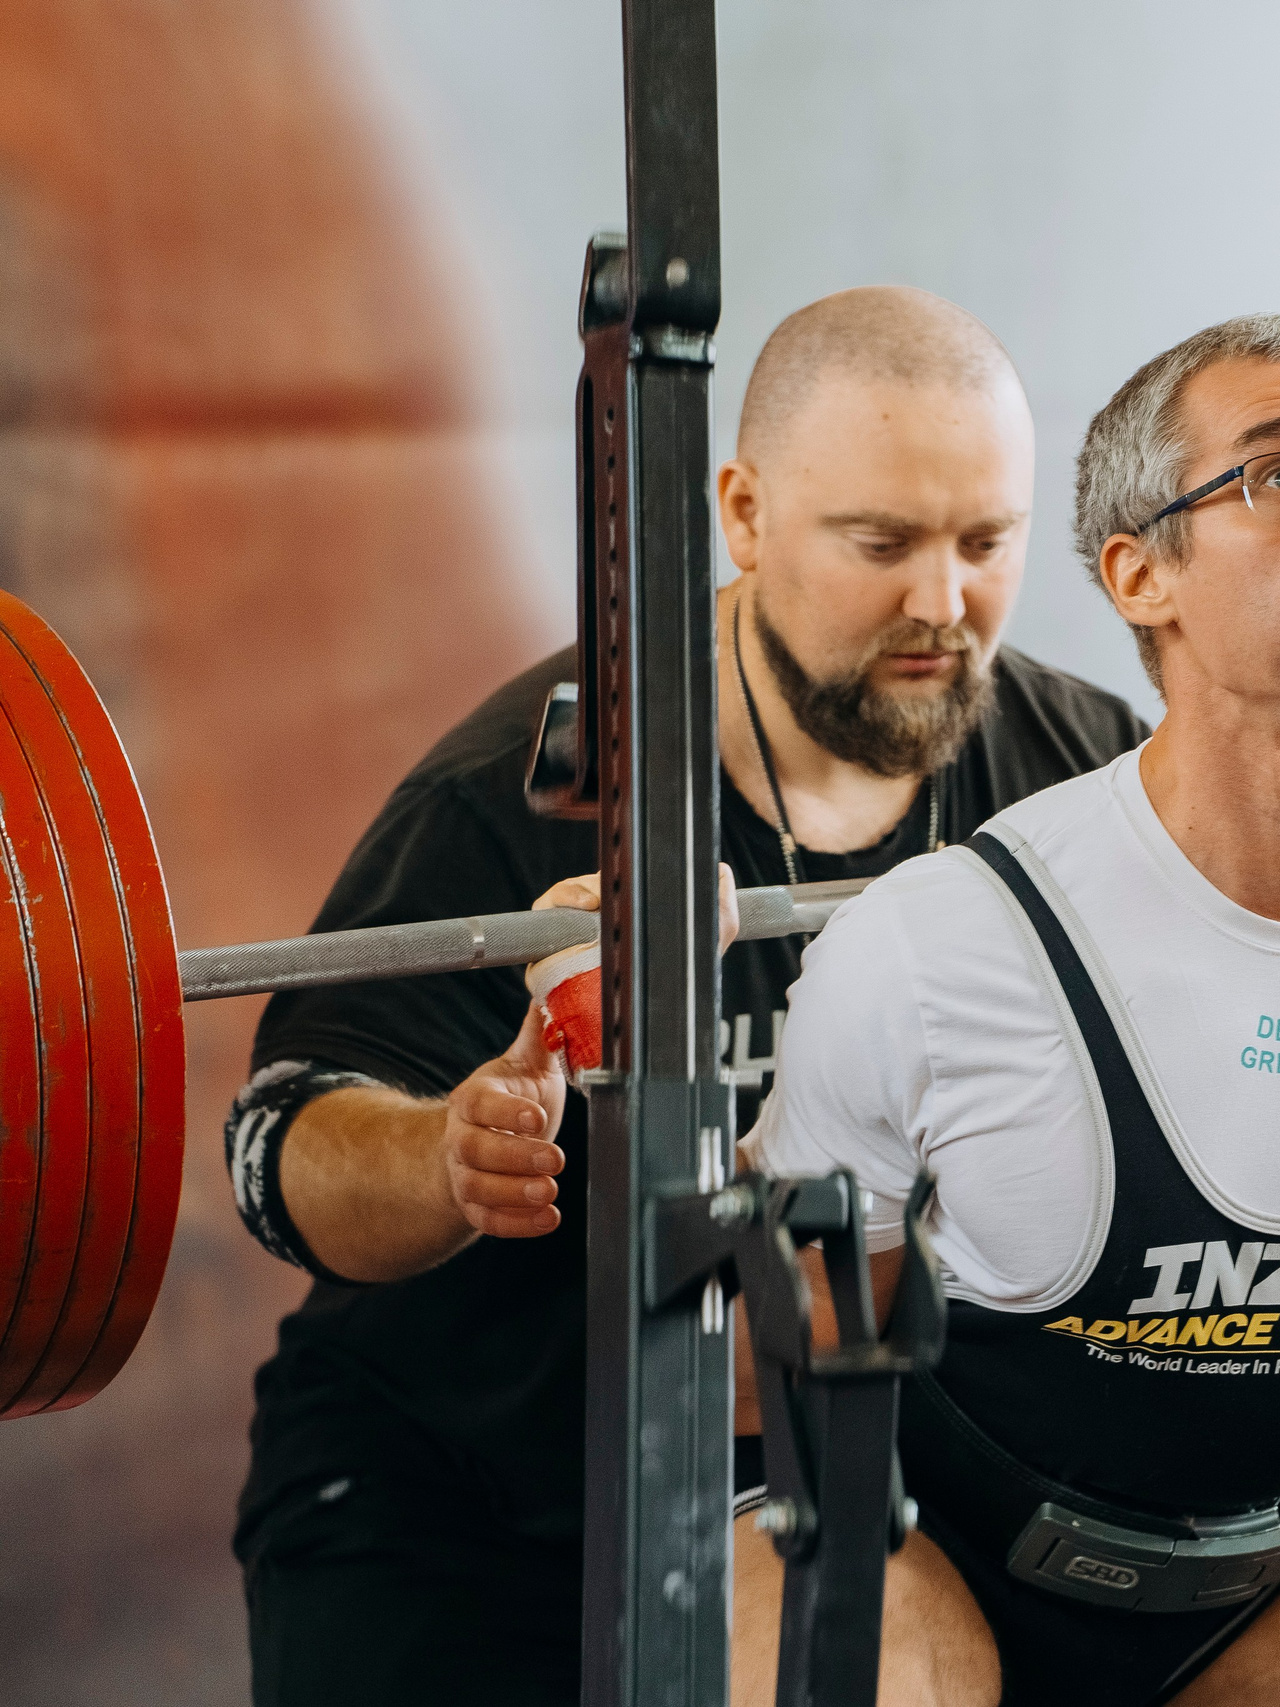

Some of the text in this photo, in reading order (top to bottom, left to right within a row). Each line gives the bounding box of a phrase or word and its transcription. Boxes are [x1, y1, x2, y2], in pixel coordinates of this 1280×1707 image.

[1086, 1343, 1124, 1363] The
[1128, 1351, 1183, 1372] World
[1185, 1357, 1251, 1375] Leader
[1252, 1358, 1270, 1375] In
